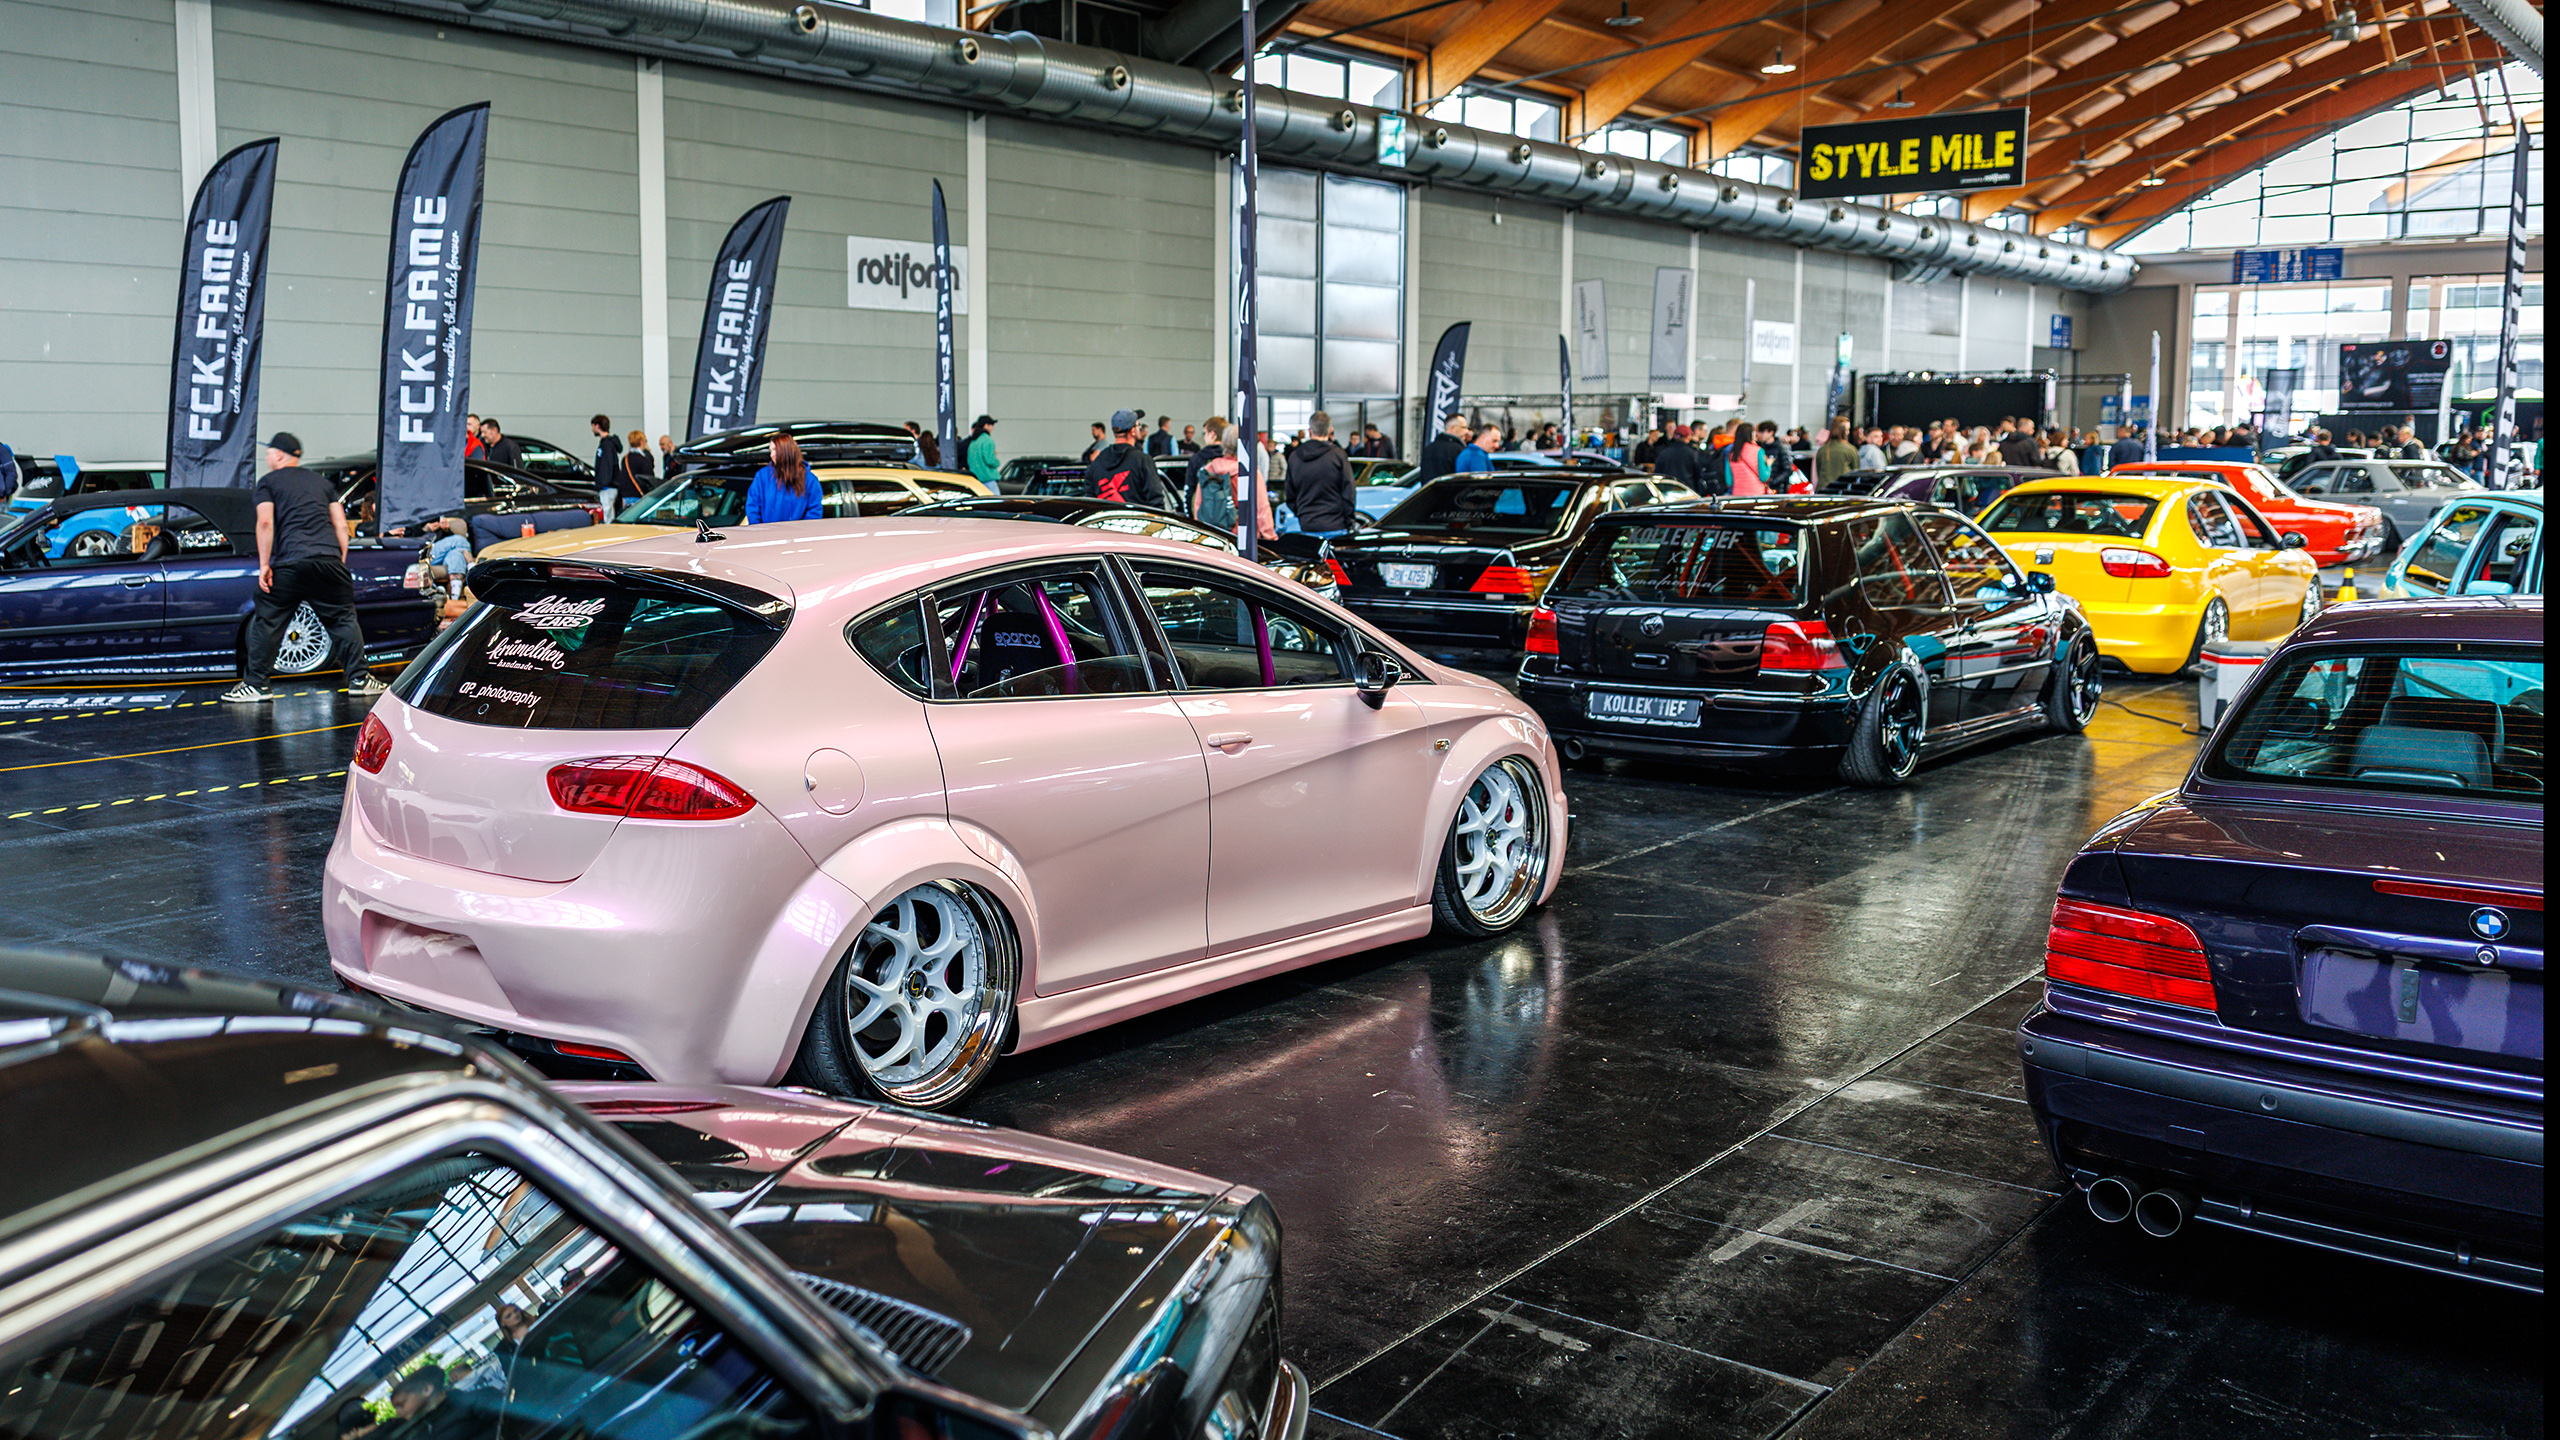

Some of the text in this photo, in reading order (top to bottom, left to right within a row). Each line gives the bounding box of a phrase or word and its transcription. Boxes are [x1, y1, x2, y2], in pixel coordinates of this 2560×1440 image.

[1809, 130, 2016, 182] STYLE MILE
[445, 230, 462, 272] forever
[443, 271, 458, 300] lasts
[189, 218, 238, 441] FCK.FAME
[399, 195, 447, 443] FCK.FAME
[443, 300, 457, 326] that
[229, 250, 252, 414] create something that lasts forever
[702, 258, 752, 436] FCK.FAME
[442, 326, 461, 379] something
[510, 595, 606, 620] Lakeside
[536, 616, 583, 628] CARS
[486, 637, 566, 670] krümelchen
[994, 631, 1041, 647] sparco
[496, 659, 534, 671] handmade
